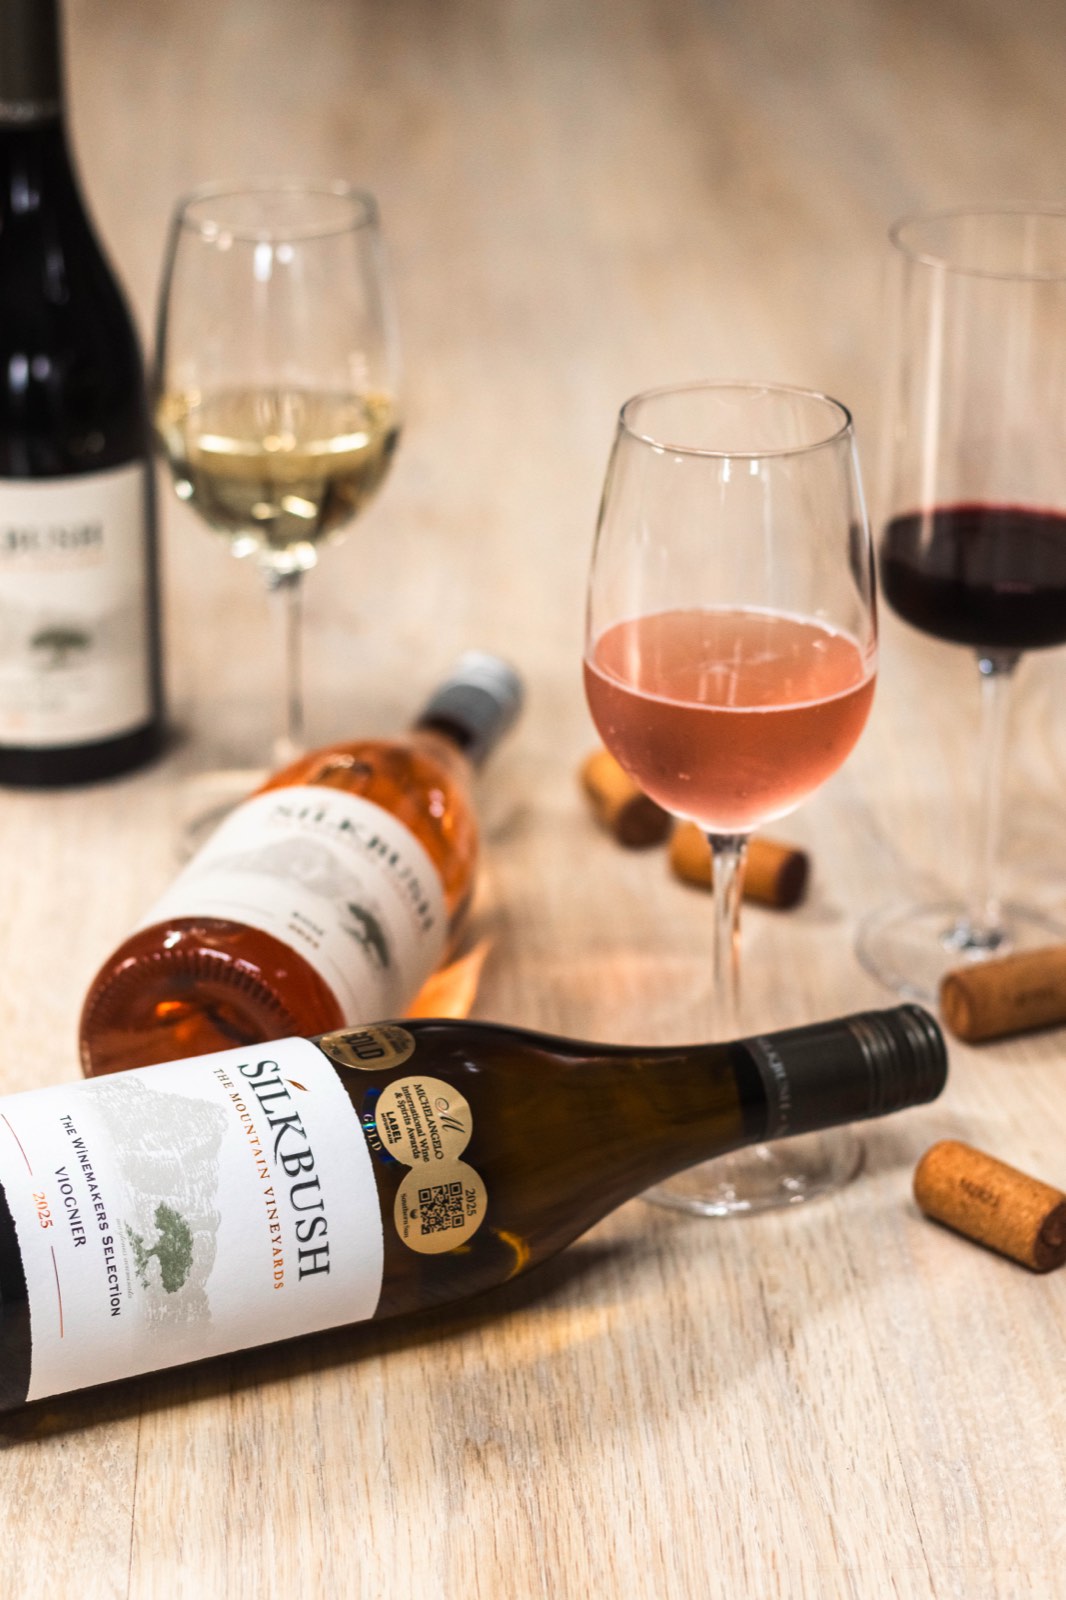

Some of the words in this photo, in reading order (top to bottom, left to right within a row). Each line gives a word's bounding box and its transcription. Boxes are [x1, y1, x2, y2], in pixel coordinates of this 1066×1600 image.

[394, 1091, 403, 1099] &
[60, 1114, 78, 1136] THE
[381, 1113, 394, 1144] MOUNTAIN
[386, 1111, 402, 1144] LABEL
[397, 1100, 412, 1126] Spirits
[401, 1085, 426, 1137] International
[419, 1137, 430, 1162] Wine
[413, 1084, 444, 1160] MICHELANGELO
[362, 1113, 383, 1151] GOLD
[406, 1127, 421, 1160] Awards
[213, 1067, 235, 1089] THE
[229, 1092, 271, 1180] MOUNTAIN
[263, 1186, 285, 1291] VINEYARDS
[237, 1059, 331, 1282] SILKBUSH
[32, 1191, 54, 1229] 2025
[54, 1166, 87, 1248] VIOGNIER
[465, 1188, 477, 1217] 2025
